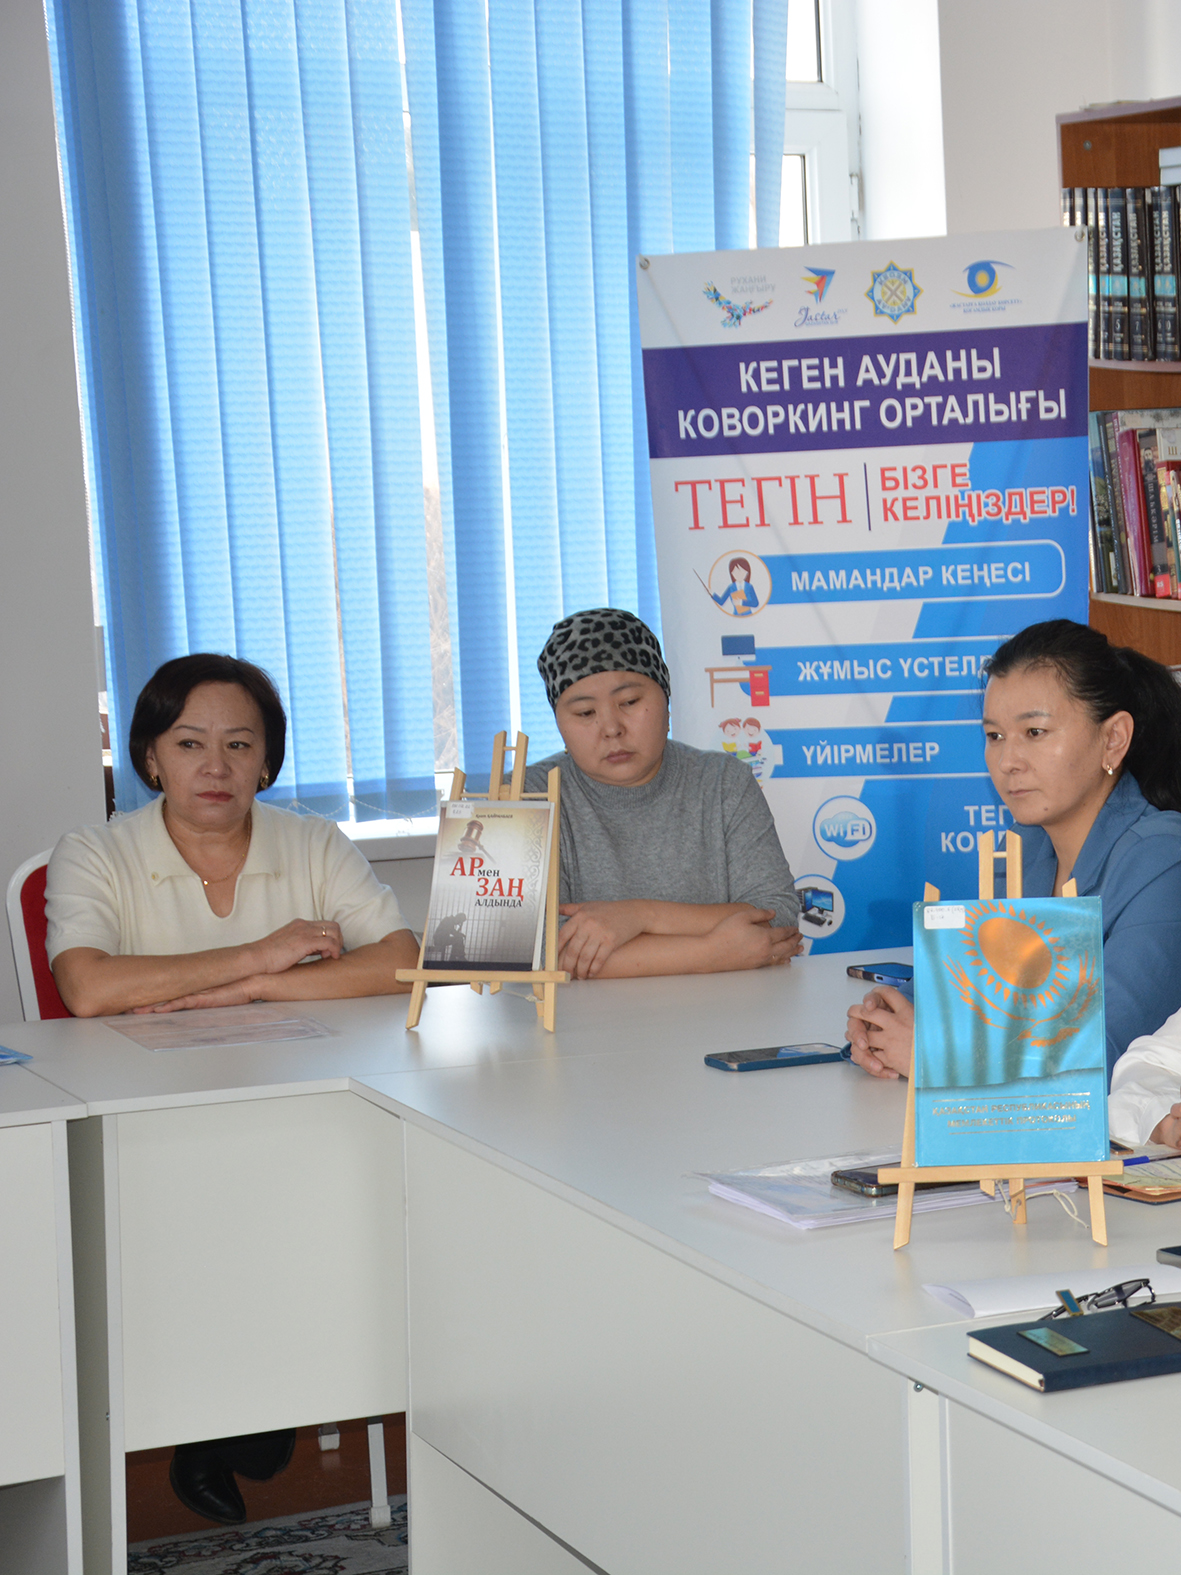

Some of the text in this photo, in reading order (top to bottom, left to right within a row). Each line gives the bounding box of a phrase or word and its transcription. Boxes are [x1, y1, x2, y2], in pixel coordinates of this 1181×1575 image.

[1113, 212, 1125, 273] ҚАЗАҚСТАН
[1130, 213, 1142, 273] ҚАЗАҚСТАН
[1162, 211, 1172, 272] ҚАЗАҚСТАН
[739, 347, 1001, 393] КЕГЕН АУДАНЫ
[677, 388, 1067, 440] КОВОРКИНГ ОРТАЛЫҒЫ
[879, 461, 970, 492] БІЗГЕ
[674, 471, 853, 531] ТЕГІН
[882, 486, 1078, 524] КЕЛІҢІЗДЕР!
[1148, 482, 1159, 543] ШАҺКӘРІМ
[791, 561, 1031, 593] МАМАНДАР КЕҢЕСІ
[797, 656, 892, 682] ЖҰМЫС
[802, 739, 940, 766] ҮЙІРМЕЛЕР
[450, 856, 500, 877] АР мен
[474, 899, 523, 908] АЛДЫНДА
[475, 877, 524, 901] ЗАҢ
[932, 1103, 989, 1116] ҚАЗАҚСТАН
[947, 1114, 1077, 1128] МЕМЛЕКЕТТІК ПРОТОКОЛЫ
